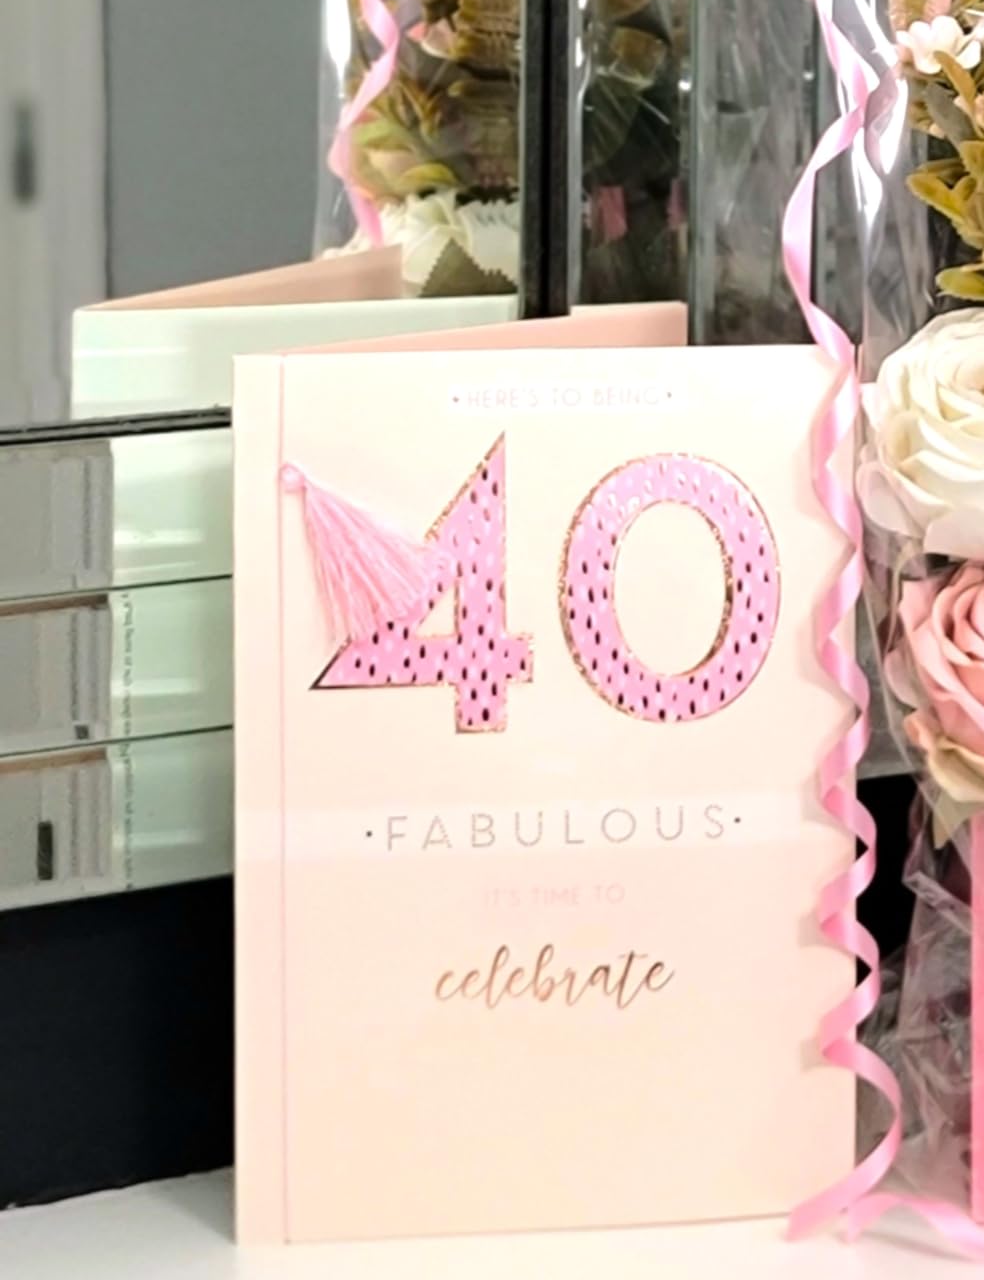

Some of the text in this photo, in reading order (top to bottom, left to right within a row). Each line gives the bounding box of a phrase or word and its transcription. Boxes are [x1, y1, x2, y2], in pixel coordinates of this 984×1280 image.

[467, 385, 659, 409] HERE'S TO BEING
[309, 430, 782, 733] 40
[386, 803, 726, 852] FABULOUS
[483, 882, 626, 908] IT'S TIME TO
[434, 942, 676, 1010] celebrate
